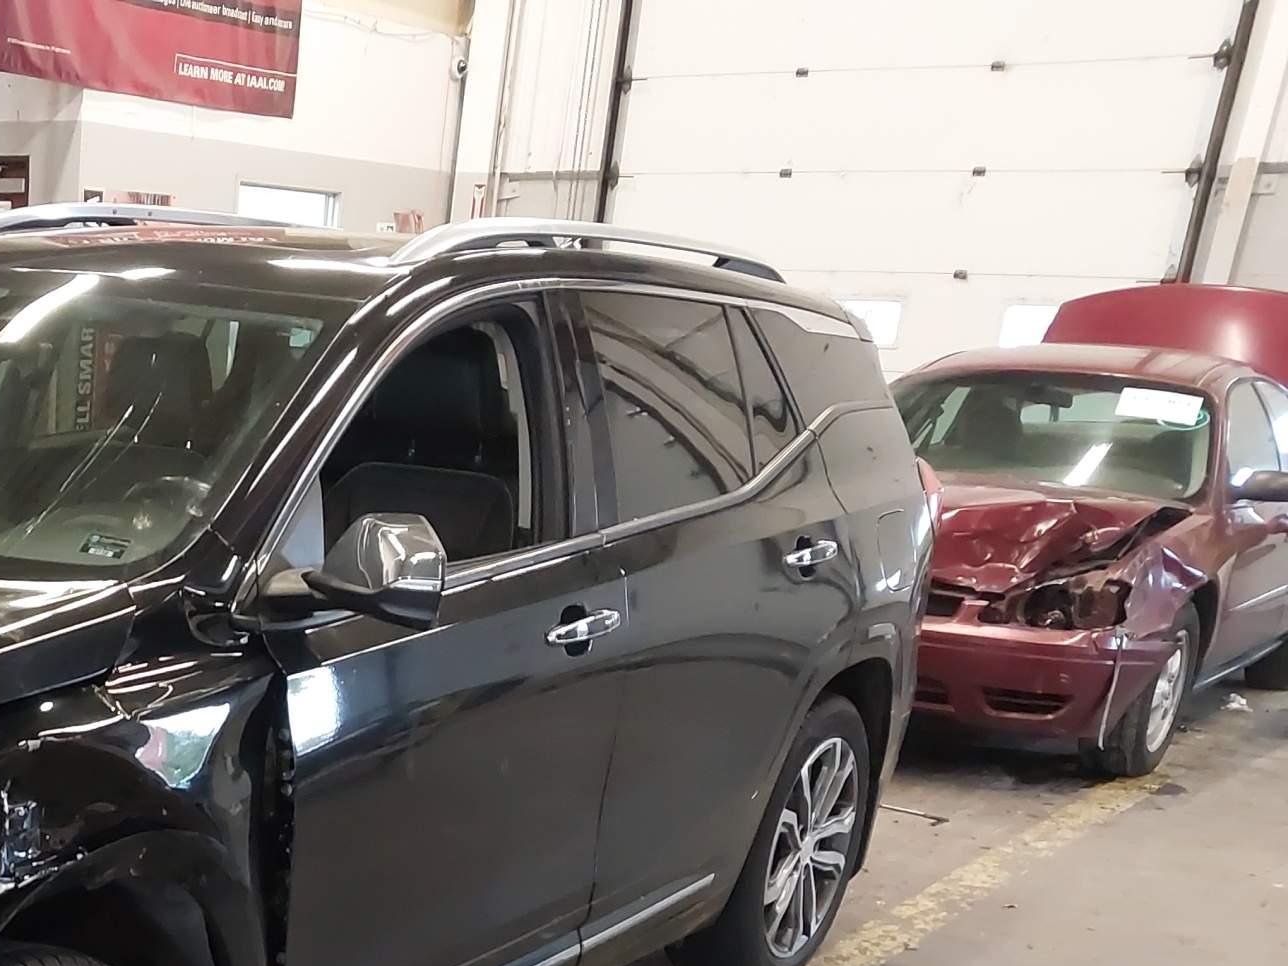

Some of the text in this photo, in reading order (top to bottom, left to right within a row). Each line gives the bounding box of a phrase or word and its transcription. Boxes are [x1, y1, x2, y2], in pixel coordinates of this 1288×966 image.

[179, 63, 286, 92] LEARN MORE AT IAAI.COM
